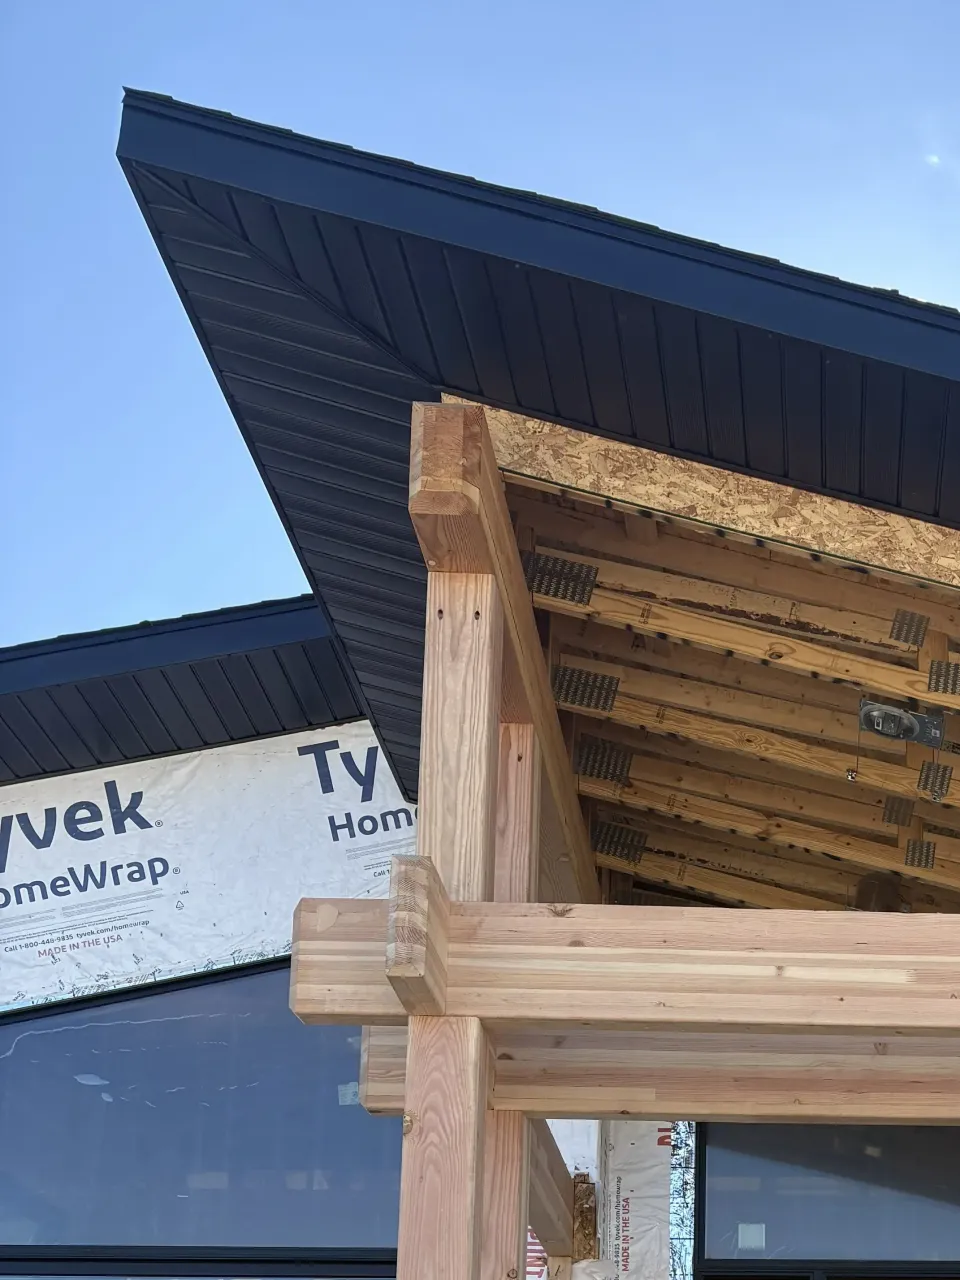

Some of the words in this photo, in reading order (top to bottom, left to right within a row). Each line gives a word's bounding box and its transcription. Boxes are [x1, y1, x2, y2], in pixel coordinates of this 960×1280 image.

[328, 807, 418, 842] Hom
[4, 944, 18, 953] Call
[76, 919, 150, 940] tyvek.com/homewrap
[38, 945, 67, 958] MADE
[69, 942, 80, 952] IN
[83, 938, 101, 949] THE
[103, 934, 123, 945] USA
[621, 1197, 630, 1215] USA
[621, 1216, 630, 1234] THE
[621, 1235, 630, 1243] IN
[621, 1246, 630, 1272] MADE
